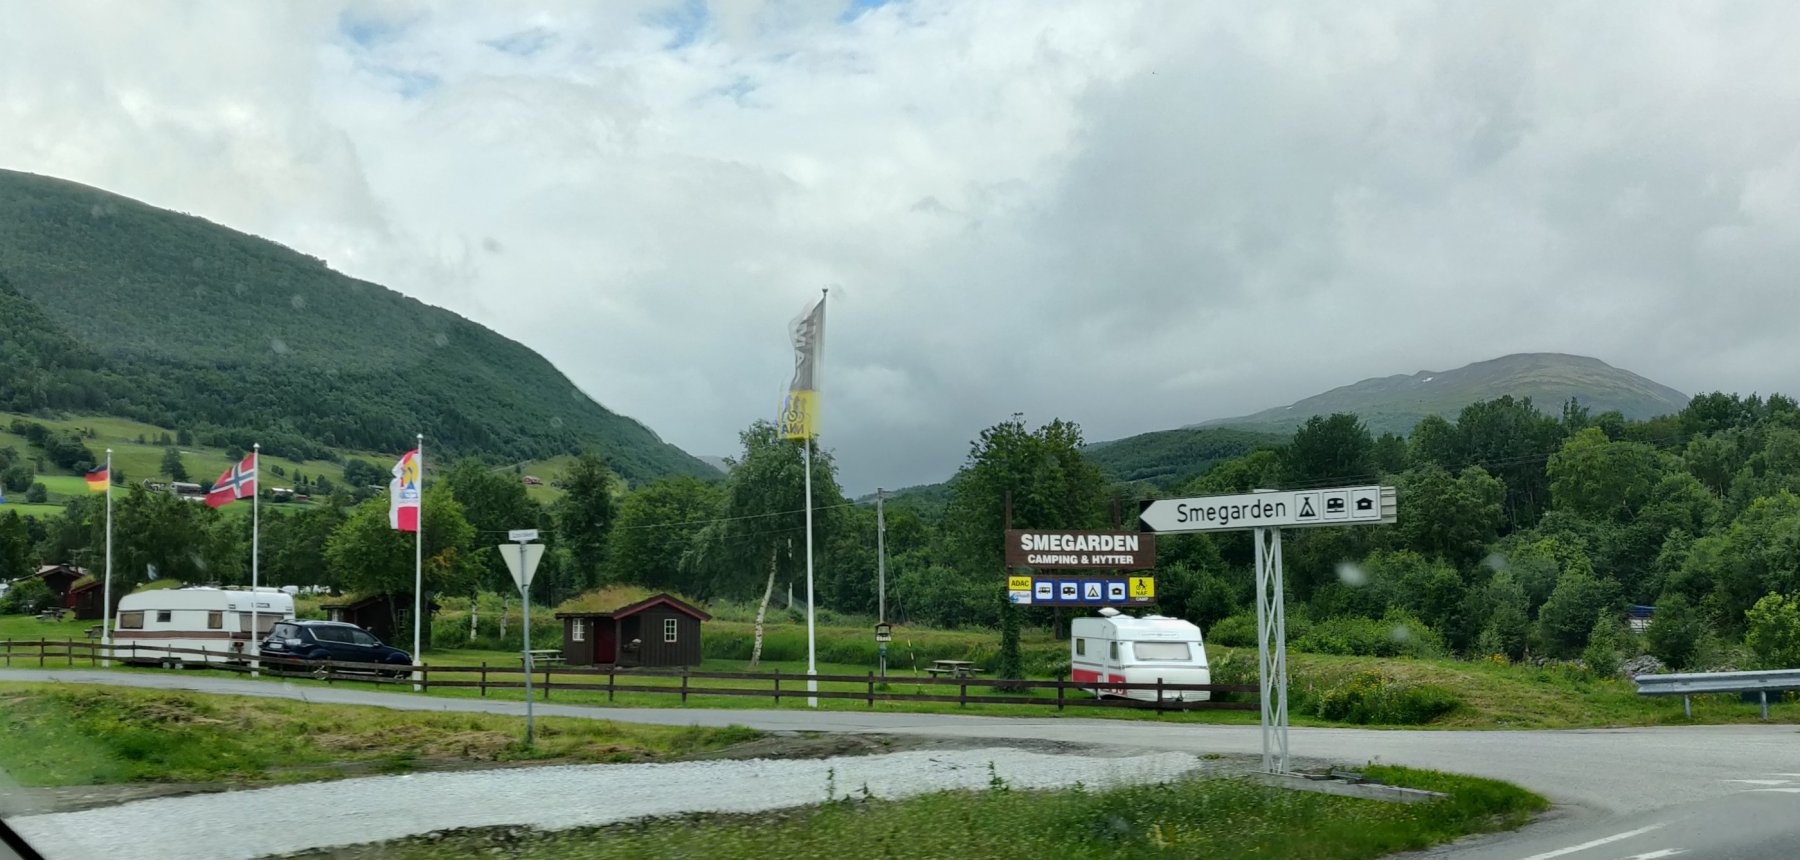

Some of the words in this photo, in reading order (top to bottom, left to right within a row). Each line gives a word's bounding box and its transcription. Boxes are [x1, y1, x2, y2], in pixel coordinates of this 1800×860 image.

[1177, 499, 1286, 525] Smegarden
[1021, 534, 1139, 551] SMEGARDEN
[1027, 554, 1078, 565] CAMPING
[1080, 554, 1089, 565] &
[1092, 555, 1134, 565] HYTTER
[1010, 579, 1030, 587] ADAC
